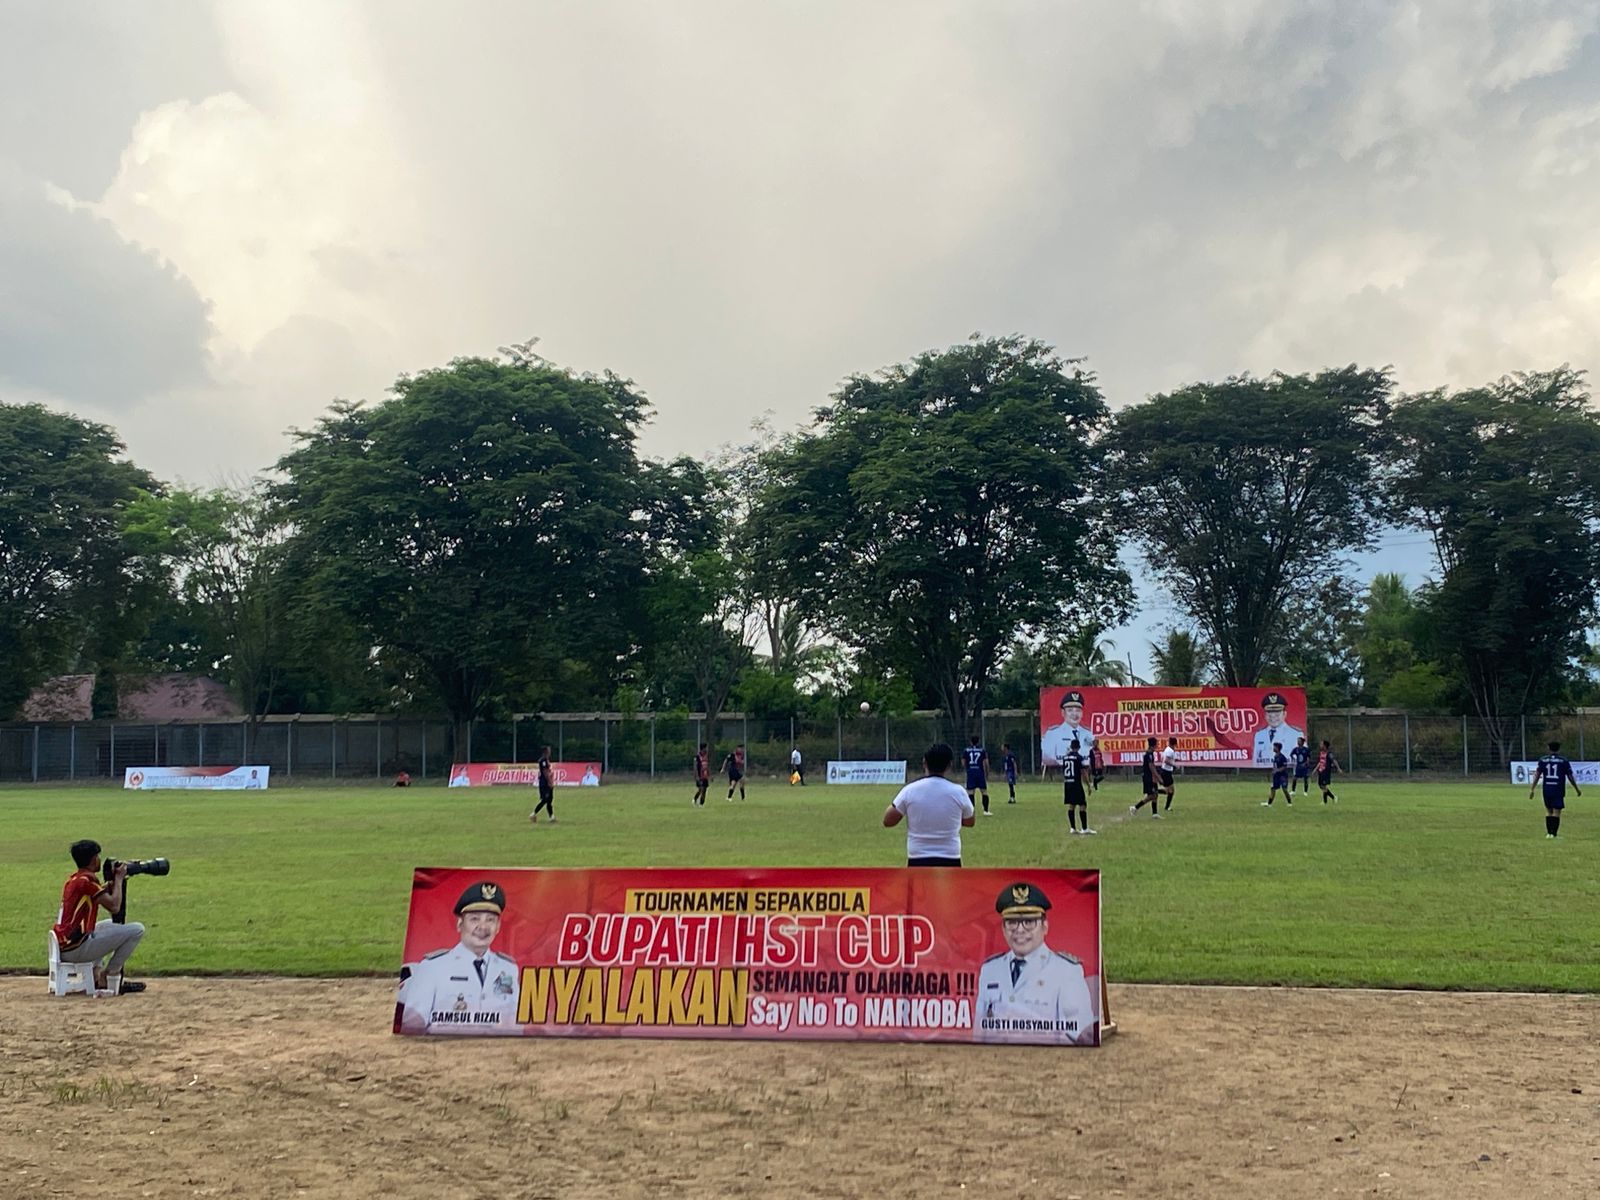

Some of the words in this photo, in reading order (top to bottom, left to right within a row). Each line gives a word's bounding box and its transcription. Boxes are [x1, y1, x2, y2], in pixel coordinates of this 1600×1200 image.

[1121, 700, 1174, 711] TOURNAMEN
[1175, 698, 1226, 710] SEPAKBOLA
[1091, 711, 1164, 736] BUPATI
[1167, 710, 1209, 734] HST
[1214, 708, 1258, 734] CUP
[1103, 739, 1146, 751] SELAMAT
[969, 752, 981, 765] 17
[1064, 760, 1075, 777] 21
[1545, 763, 1559, 779] 11
[634, 891, 748, 912] TOURNAMEN
[754, 891, 866, 912] SEPAKBOLA
[558, 913, 721, 966] BUPATI
[732, 914, 826, 967] HST
[835, 914, 936, 968] CUP
[752, 971, 850, 993] SEMANGAT
[854, 971, 950, 996] OLAHRAGA
[956, 972, 976, 997] !!!
[516, 966, 750, 1027] NYALAKAN
[431, 1011, 472, 1024] SAMSUL
[473, 1011, 501, 1024] RIZAL
[751, 995, 793, 1032] Say
[796, 997, 827, 1027] No
[832, 997, 858, 1027] To
[863, 997, 973, 1029] NARKOBA
[981, 1018, 1010, 1030] GUSTI
[1012, 1019, 1053, 1031] ROSYADI
[1055, 1020, 1078, 1031] ELMI
